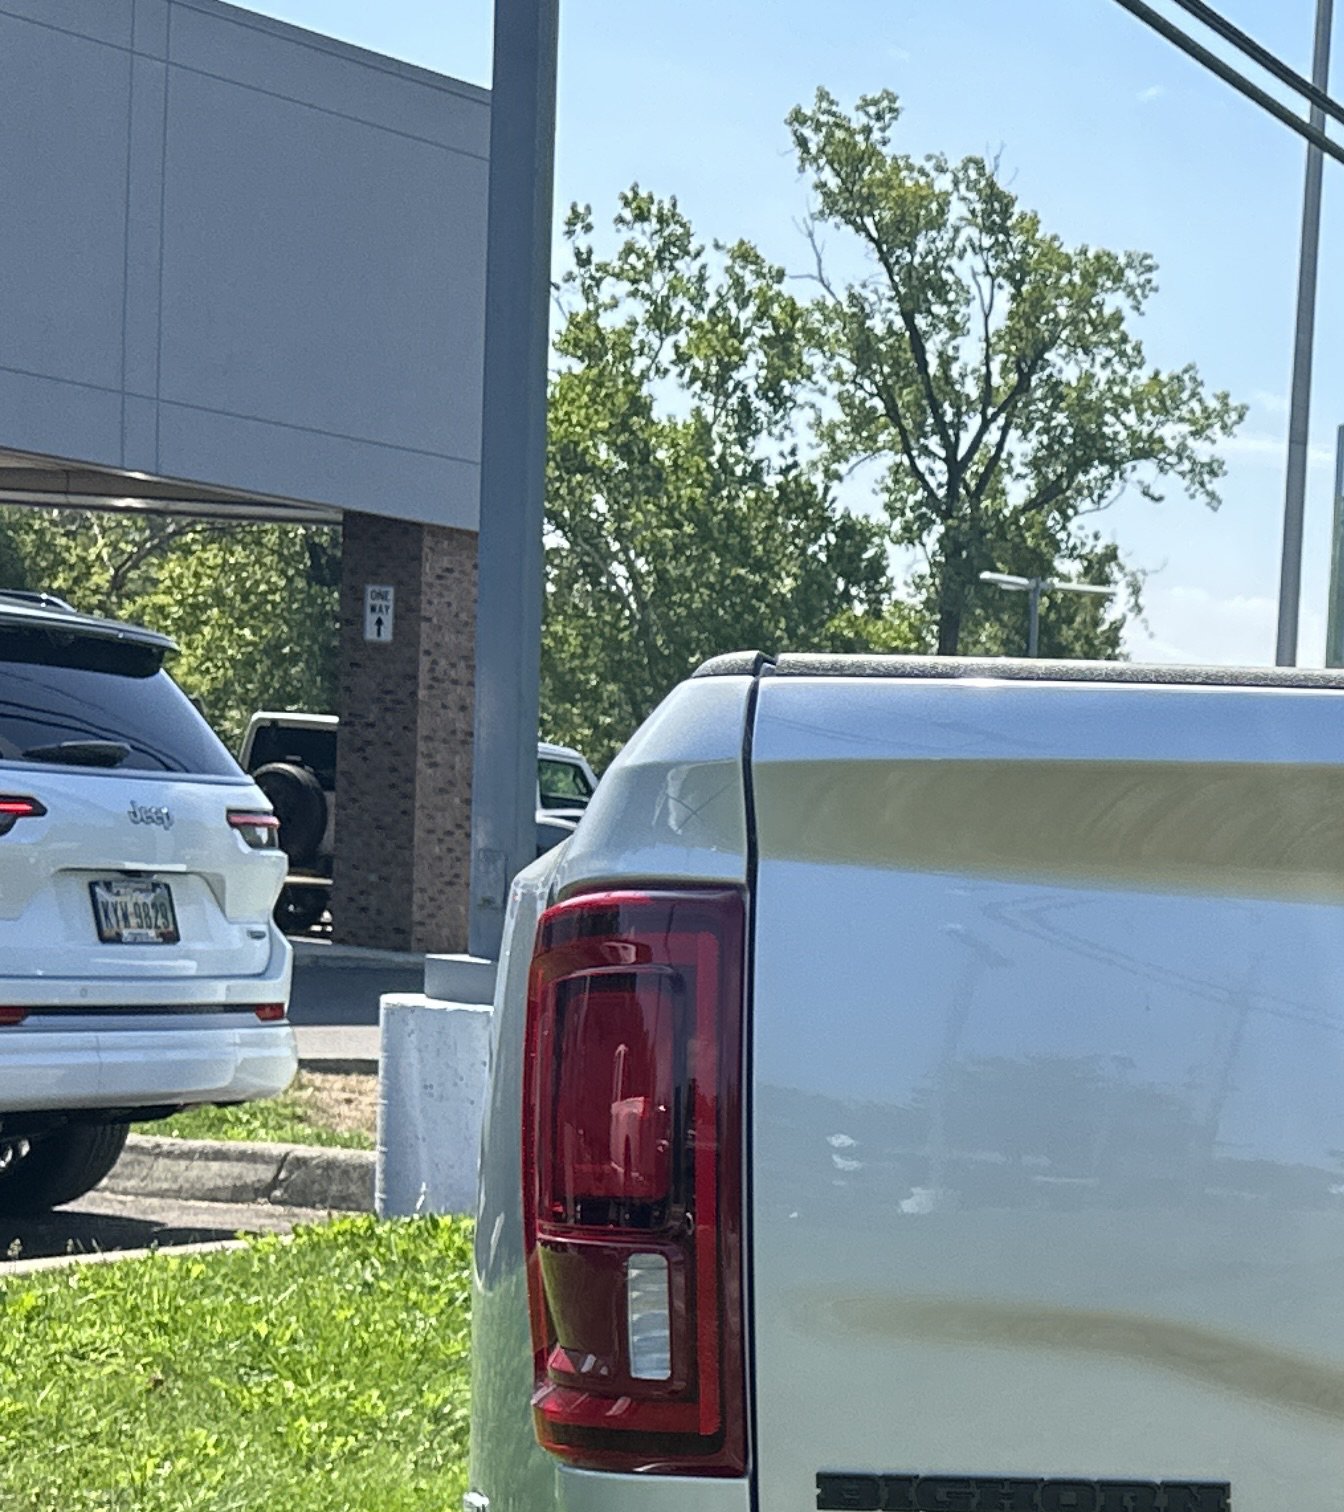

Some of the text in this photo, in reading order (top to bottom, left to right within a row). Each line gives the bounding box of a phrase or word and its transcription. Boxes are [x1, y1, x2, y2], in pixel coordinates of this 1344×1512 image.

[370, 590, 390, 601] ONE
[370, 603, 390, 615] WAY
[128, 800, 174, 830] Jeep
